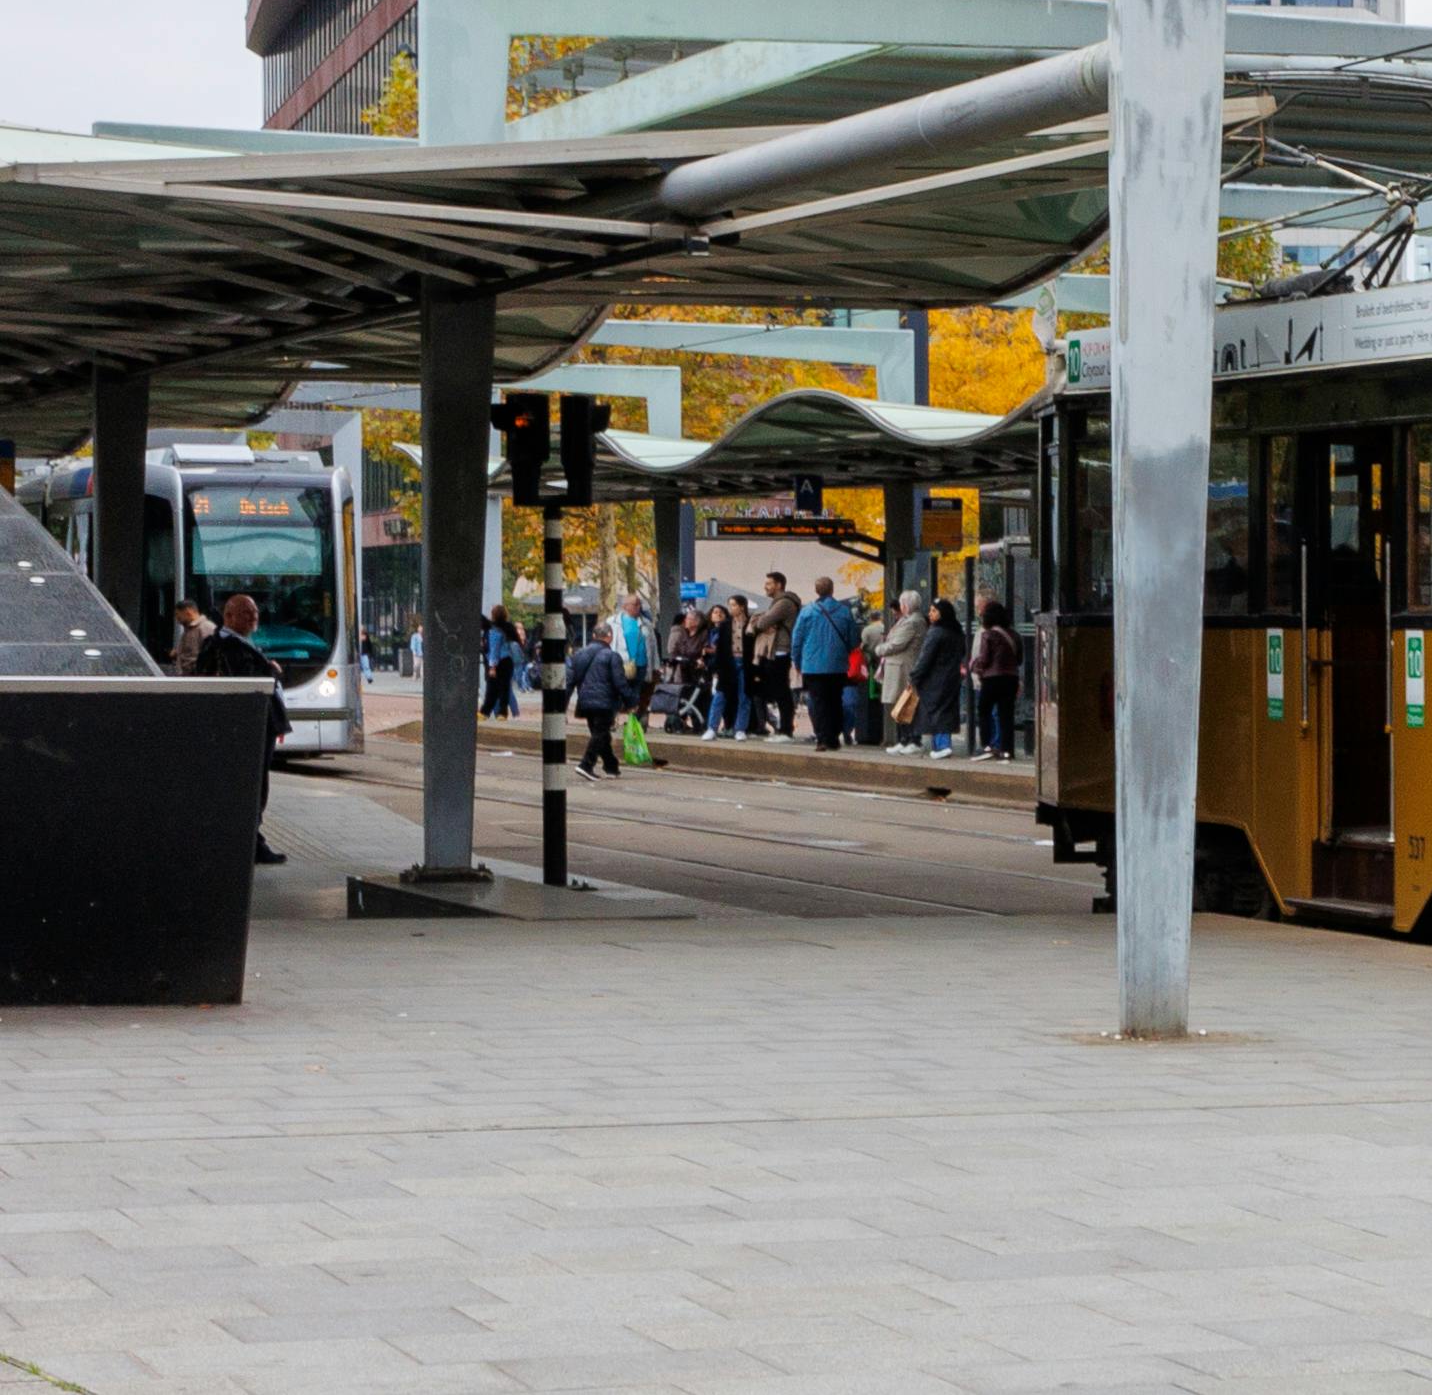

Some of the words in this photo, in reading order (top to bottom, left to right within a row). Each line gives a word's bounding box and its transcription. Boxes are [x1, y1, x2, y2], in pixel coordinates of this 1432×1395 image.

[800, 478, 814, 494] A
[1408, 650, 1423, 677] 10
[1408, 835, 1425, 860] 537
